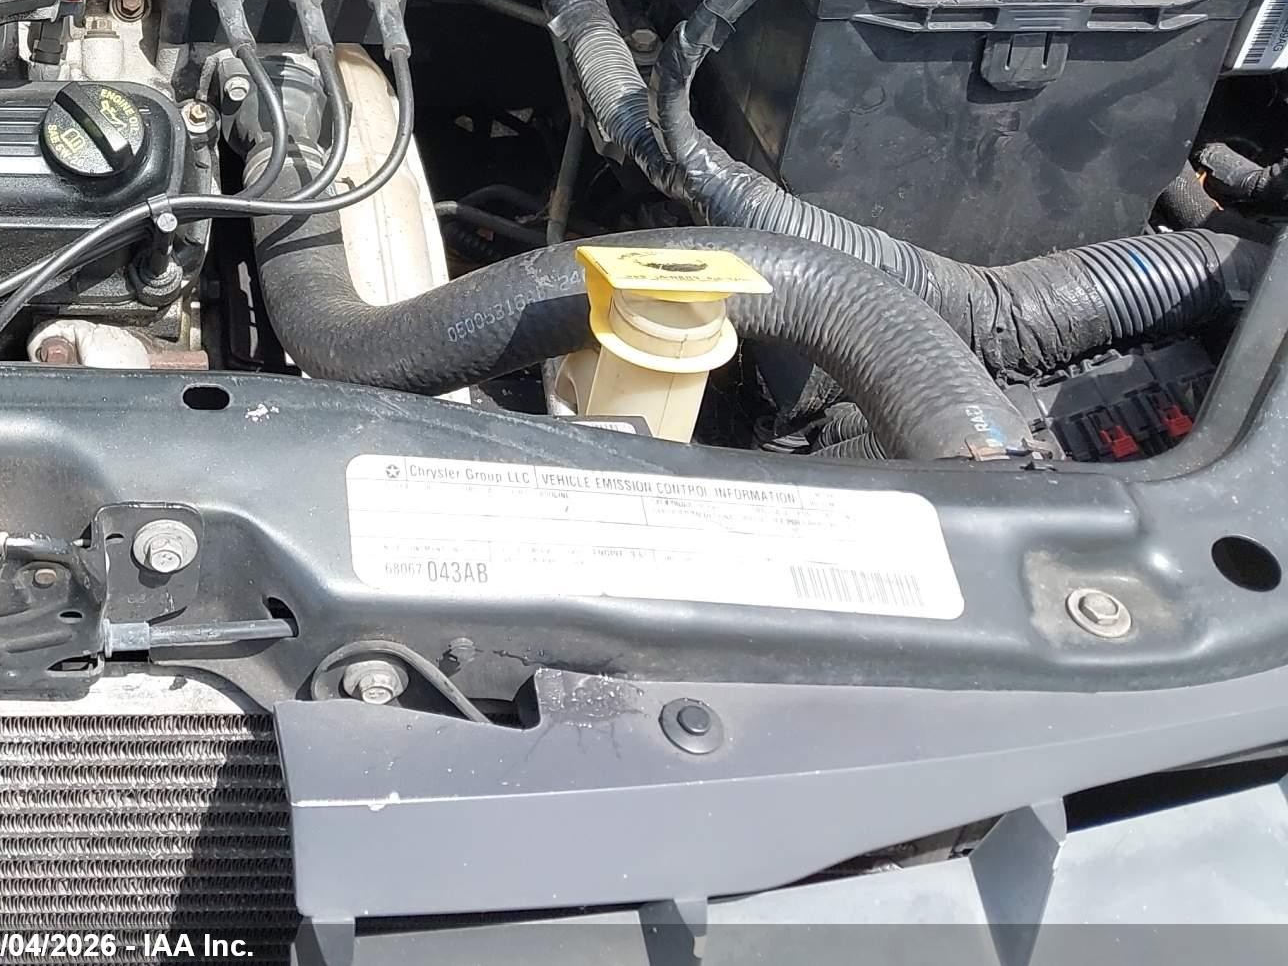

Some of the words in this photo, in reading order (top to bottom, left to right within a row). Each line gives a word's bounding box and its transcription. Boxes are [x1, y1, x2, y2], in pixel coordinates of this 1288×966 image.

[100, 88, 135, 117] ENGINE
[128, 114, 141, 137] OIL
[410, 464, 460, 481] Chrysler
[465, 468, 503, 483] Group
[507, 472, 530, 484] LLC
[541, 473, 591, 489] VEHICLE
[595, 477, 653, 493] EMISSION
[656, 482, 707, 497] CONTROL
[715, 487, 796, 504] INFORMATION
[427, 560, 489, 584] 043AB
